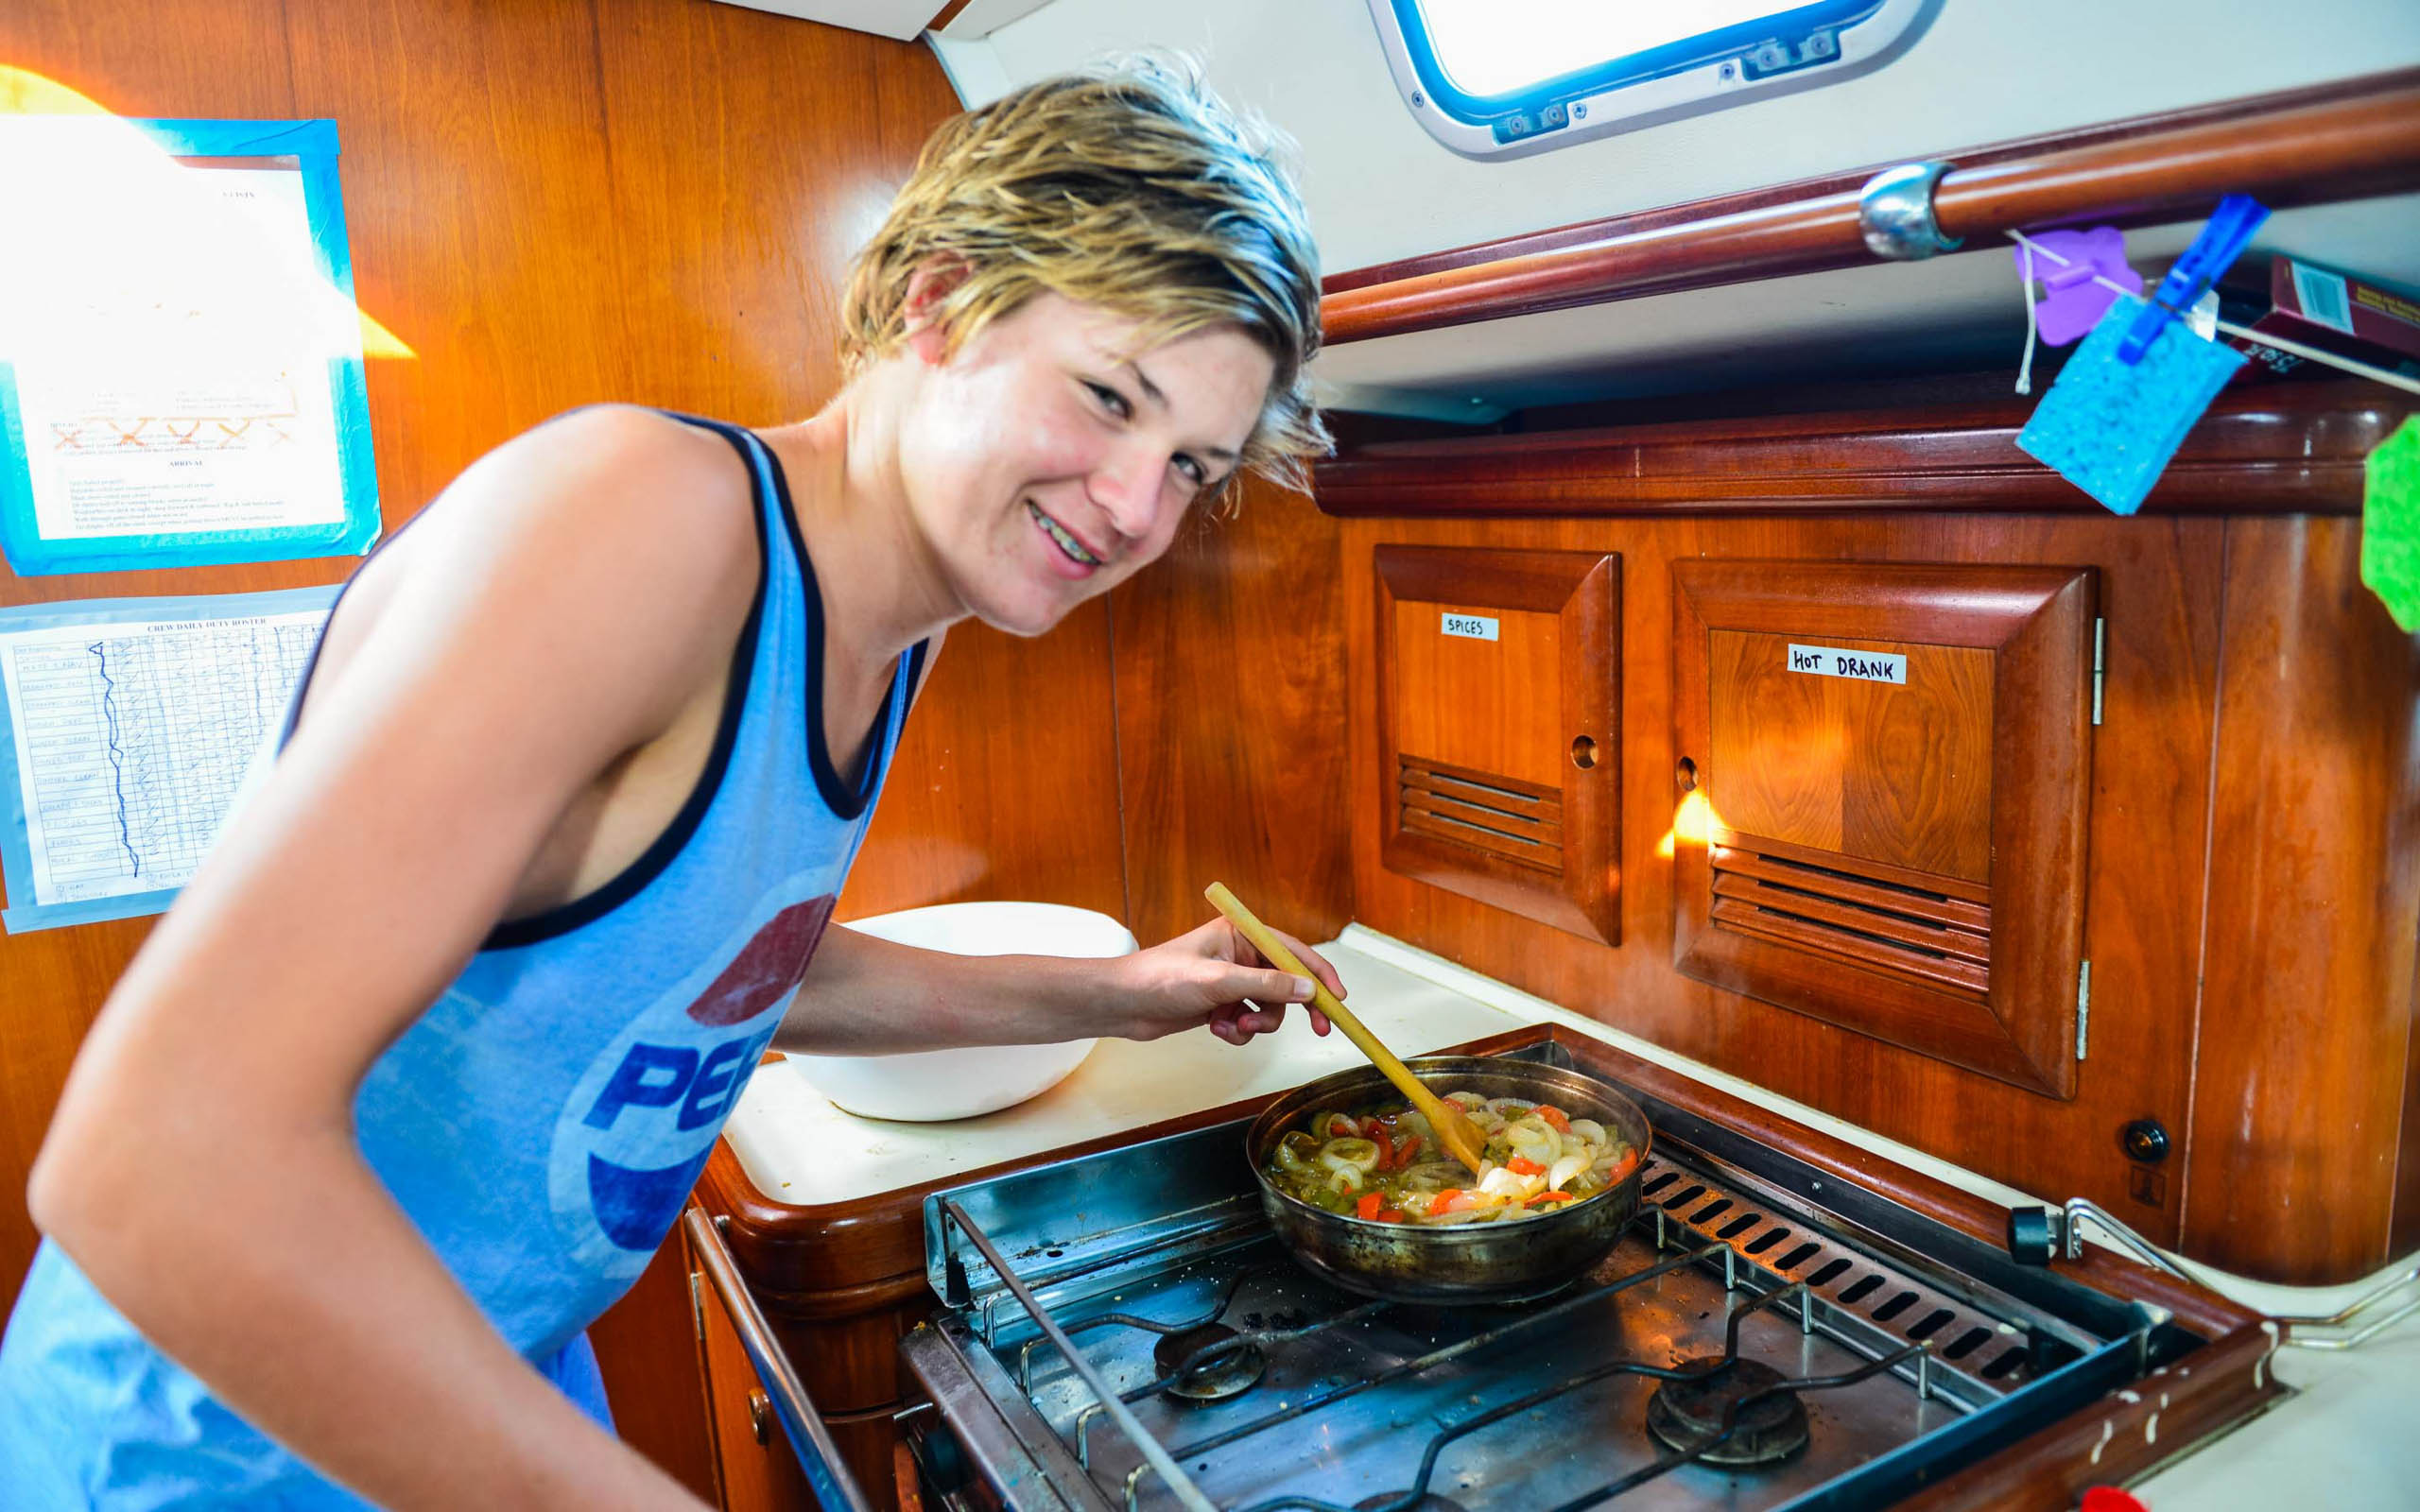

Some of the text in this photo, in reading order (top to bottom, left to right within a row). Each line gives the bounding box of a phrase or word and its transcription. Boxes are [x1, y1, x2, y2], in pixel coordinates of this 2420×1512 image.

[147, 624, 174, 632] CREW
[176, 622, 202, 630] DAILY
[232, 617, 267, 627] ROSTER
[1447, 618, 1483, 635] SPICES
[1793, 650, 1894, 680] HOT DRANK
